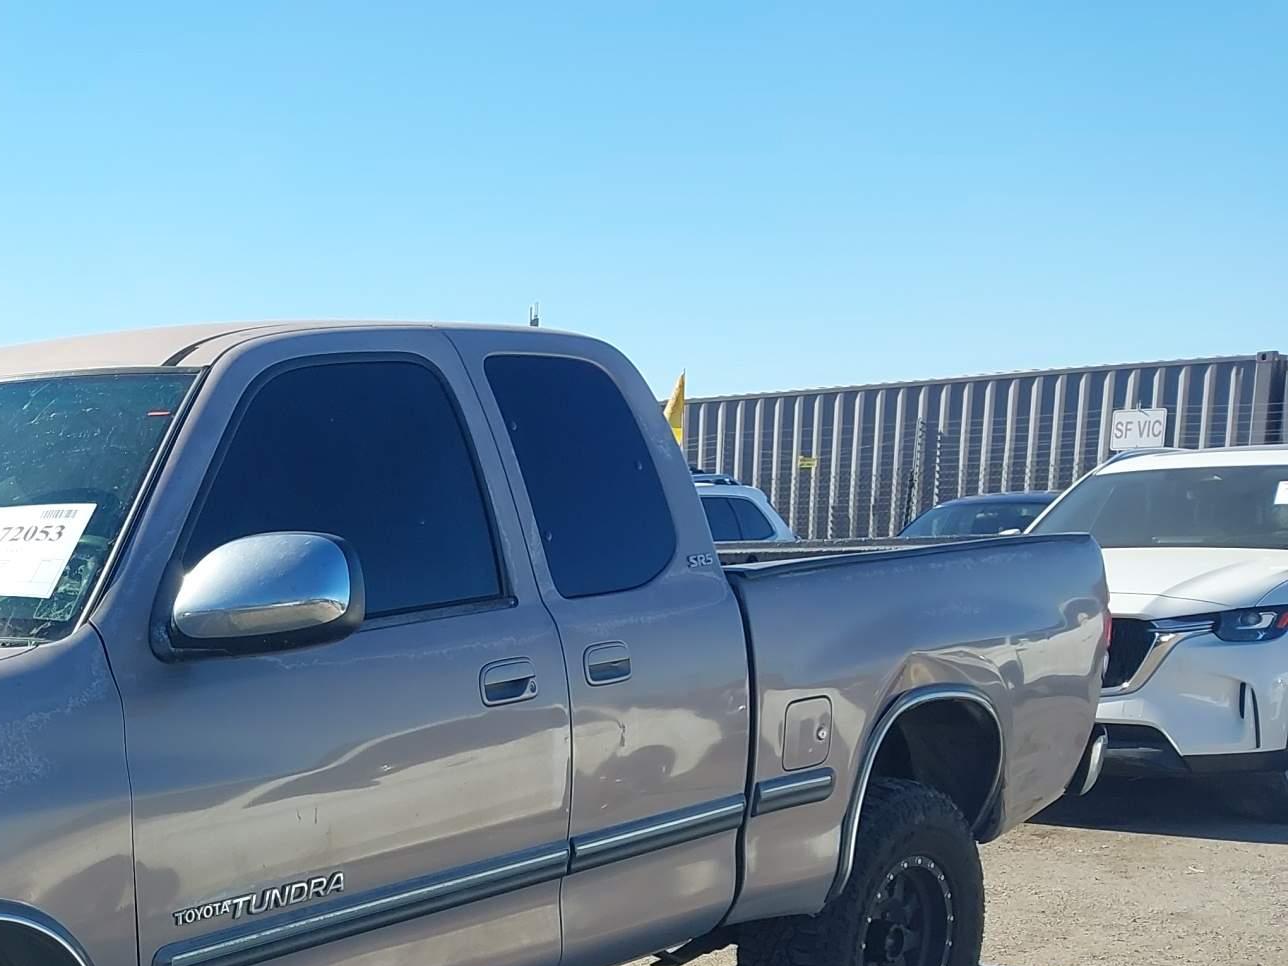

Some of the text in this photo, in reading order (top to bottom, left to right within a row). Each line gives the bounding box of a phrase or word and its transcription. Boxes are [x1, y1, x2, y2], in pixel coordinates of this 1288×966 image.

[1114, 420, 1162, 439] SF VIC
[687, 553, 713, 568] SR5
[173, 871, 345, 927] TOYOTA TUNDRA
